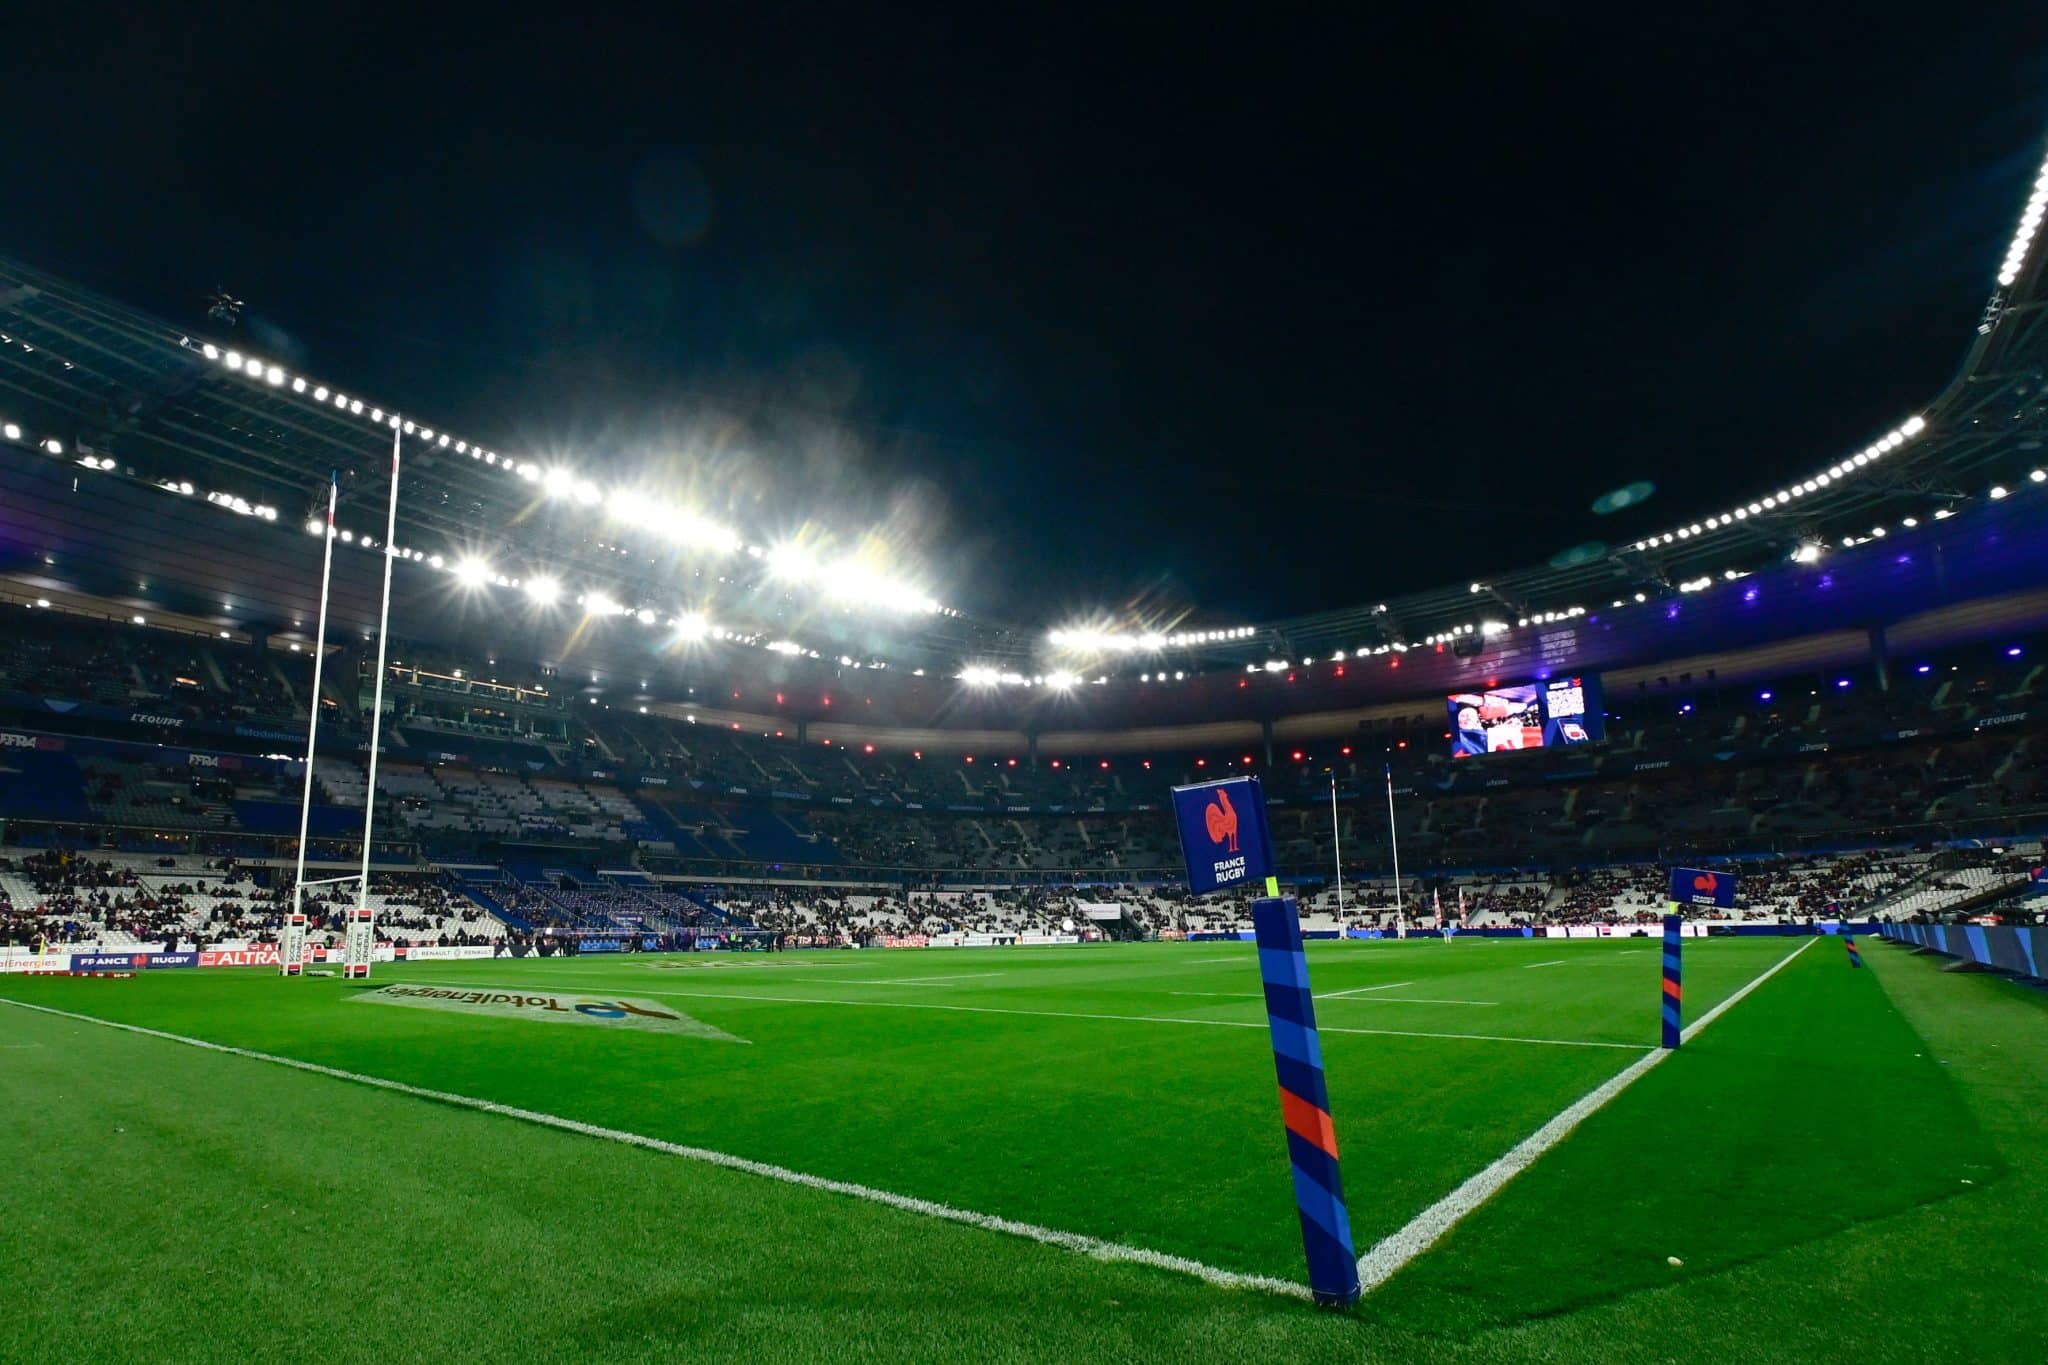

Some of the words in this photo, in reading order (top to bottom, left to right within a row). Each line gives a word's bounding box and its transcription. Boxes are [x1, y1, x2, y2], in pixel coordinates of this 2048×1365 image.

[1214, 856, 1246, 873] FRANCE
[1216, 866, 1246, 884] RUGBY
[152, 956, 190, 964] RUGBY
[377, 985, 569, 1012] TotalEnergies
